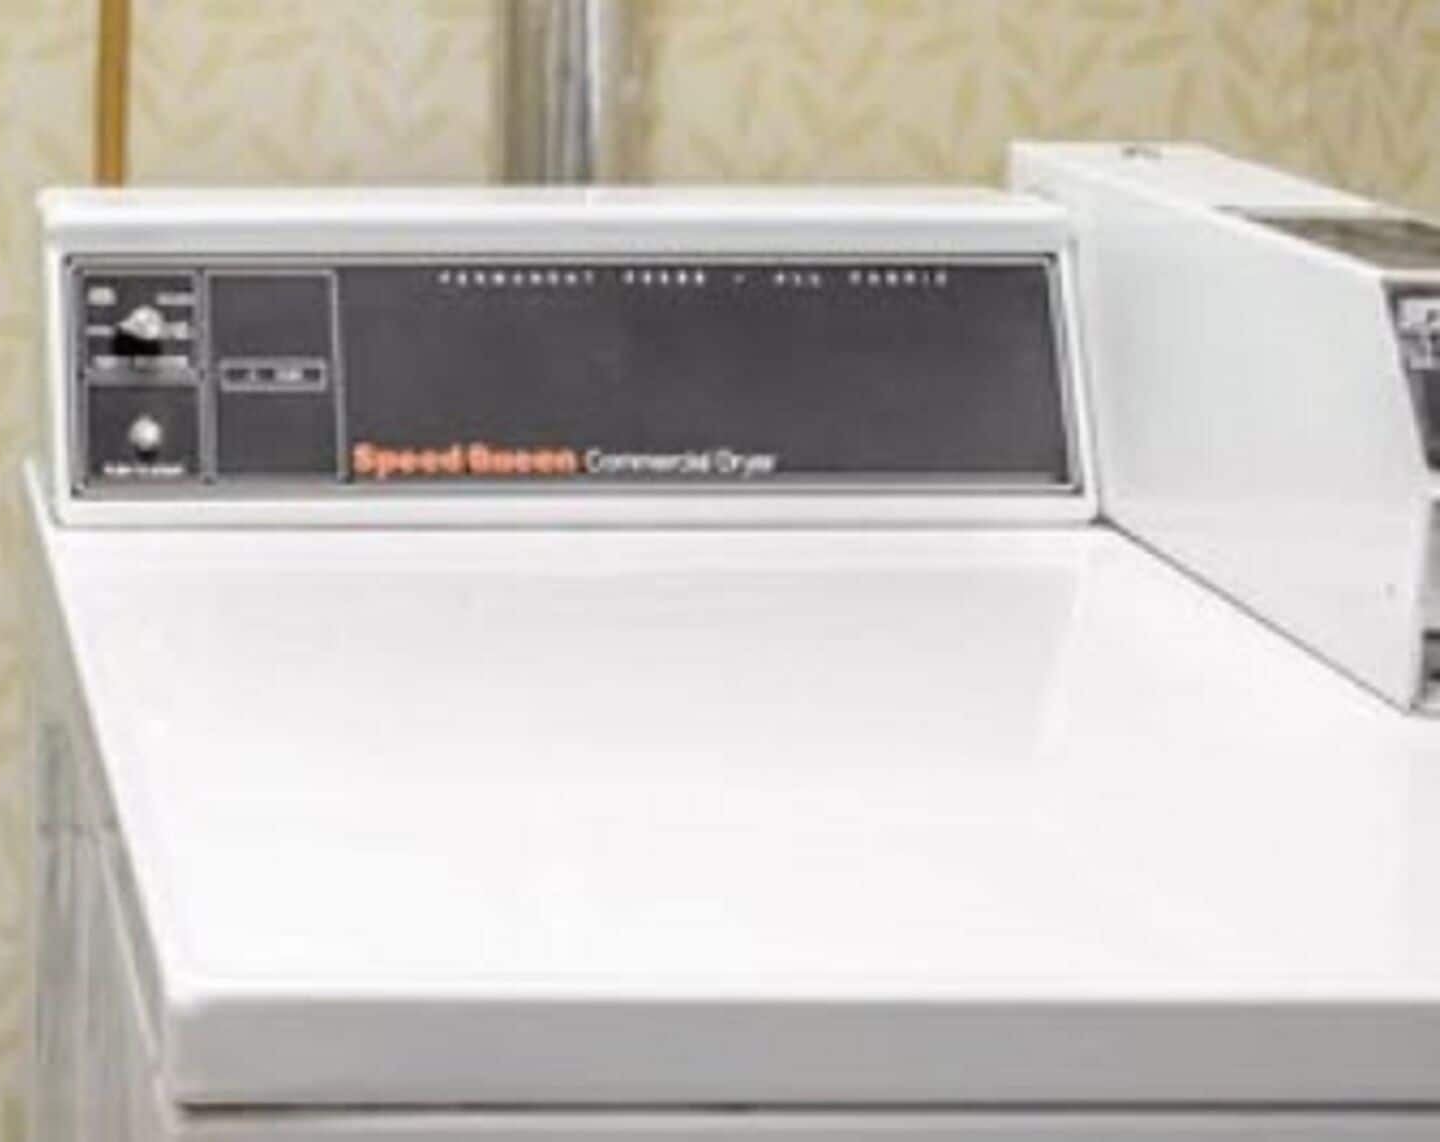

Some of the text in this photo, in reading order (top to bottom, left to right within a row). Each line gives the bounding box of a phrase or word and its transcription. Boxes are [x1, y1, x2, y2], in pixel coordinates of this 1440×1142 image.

[353, 441, 775, 479] Speed Queen Commercial Dryer
